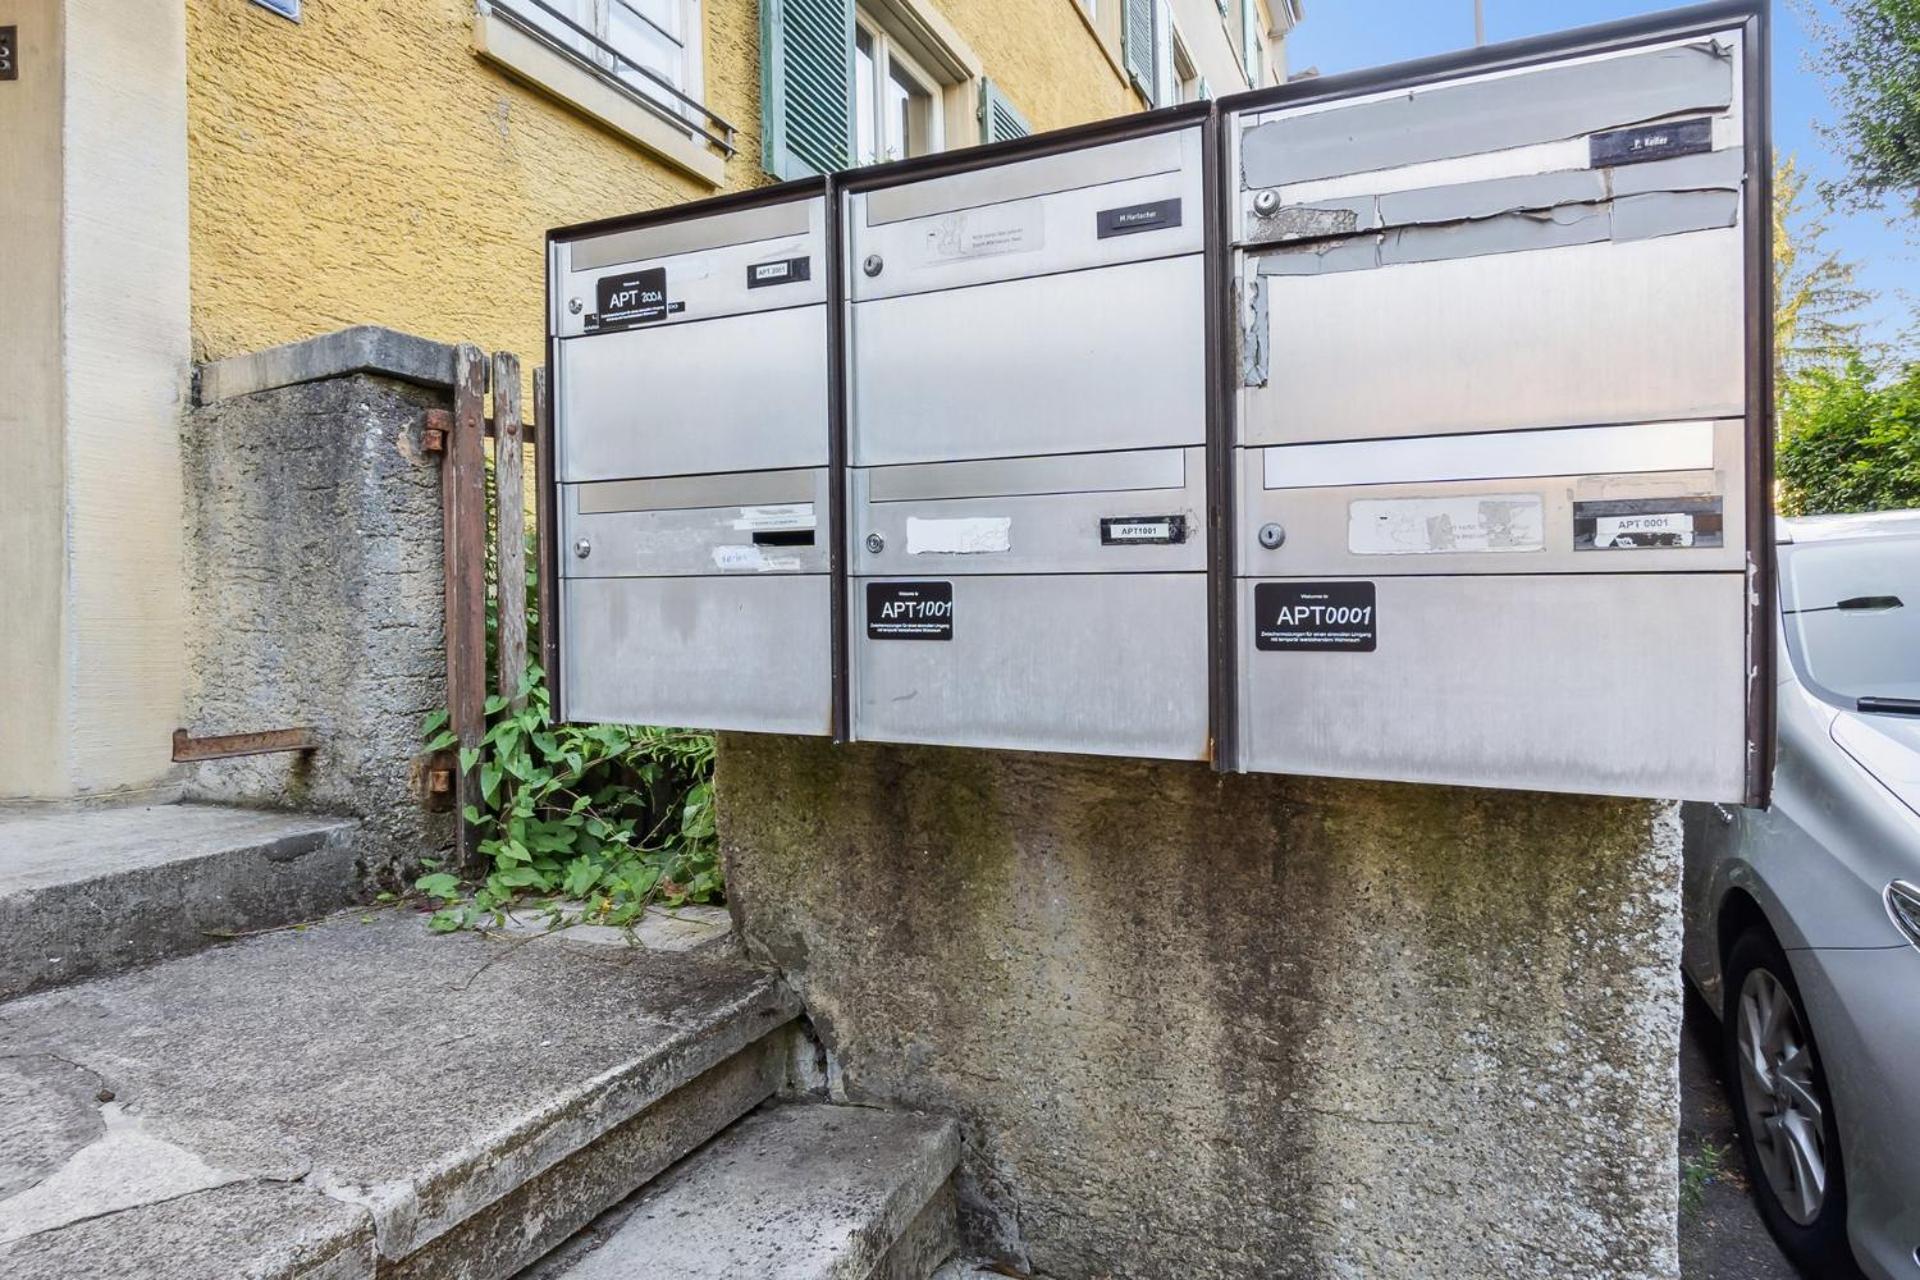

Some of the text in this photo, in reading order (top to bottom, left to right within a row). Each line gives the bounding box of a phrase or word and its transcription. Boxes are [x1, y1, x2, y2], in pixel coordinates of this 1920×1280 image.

[609, 290, 639, 309] APT
[1121, 526, 1157, 535] APT1001
[1618, 518, 1669, 529] APT 0001
[881, 601, 953, 618] APT1001
[1276, 605, 1372, 626] APT0001
